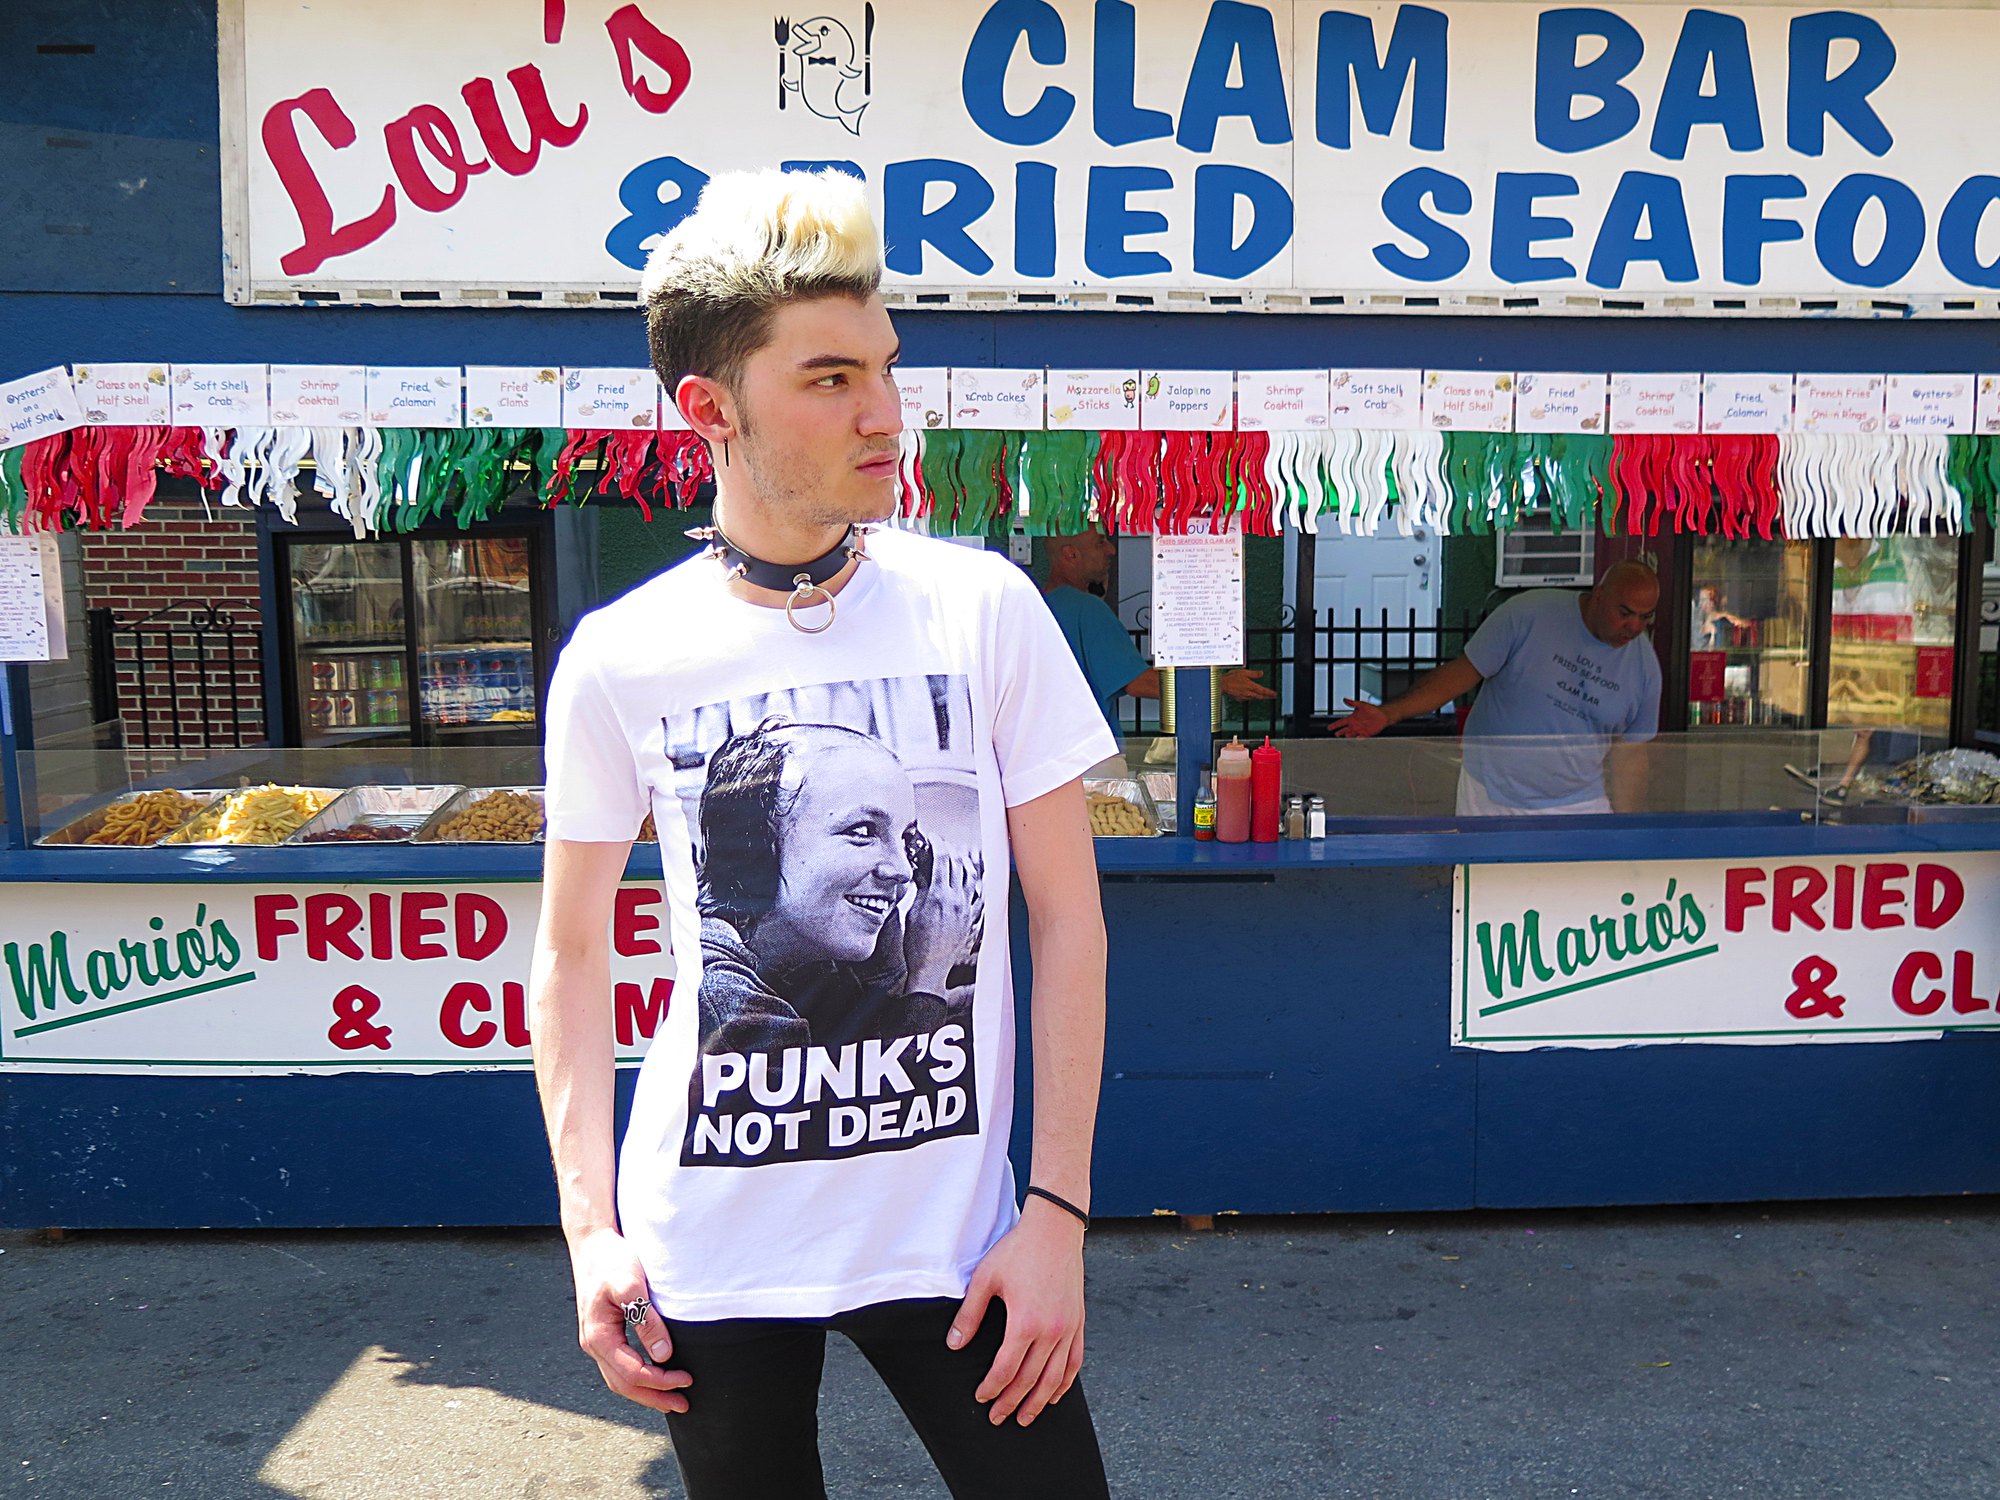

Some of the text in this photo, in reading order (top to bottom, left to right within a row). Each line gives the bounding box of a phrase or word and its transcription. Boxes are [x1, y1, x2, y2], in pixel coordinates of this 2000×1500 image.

[962, 0, 1897, 160] CLAM BAR
[261, 0, 691, 276] Lou's
[781, 159, 1293, 279] RIED
[128, 382, 140, 390] on
[193, 380, 248, 392] Soft Shell
[301, 380, 338, 392] Shrimp
[401, 382, 429, 393] Fried
[500, 381, 528, 392] Fried
[597, 384, 625, 394] Fried
[897, 384, 923, 394] conut
[1066, 384, 1121, 395] Mozzarella
[1266, 385, 1301, 397] Shrimp
[1350, 383, 1402, 396] Soft Shell
[7, 385, 46, 404] Oysters
[970, 391, 1026, 402] Crab Cakes
[1474, 388, 1488, 397] on
[1548, 387, 1575, 398] Fried
[1638, 390, 1675, 403] Shrimp
[1734, 392, 1761, 403] Fried
[1809, 387, 1871, 399] French Fries
[1912, 389, 1953, 401] Oysters
[97, 395, 150, 407] Half Shell
[208, 396, 232, 406] Crab
[393, 397, 437, 407] Calamari
[499, 397, 529, 408] Clams
[592, 399, 629, 412] Shrimp
[1078, 399, 1110, 410] Sticks
[1169, 400, 1208, 413] Poppers
[1363, 398, 1388, 409] Crab
[1443, 401, 1493, 412] Half Shell
[23, 405, 33, 414] on
[1543, 402, 1579, 415] Shrimp
[1727, 407, 1768, 419] Calamari
[10, 409, 62, 432] Half Shell
[1905, 414, 1955, 426] Half Shell
[1576, 654, 1602, 674] LOUS
[1552, 653, 1620, 692] FRIED SEAFOOD
[1582, 692, 1600, 706] BAR
[1724, 863, 1965, 933] FRIED
[254, 892, 508, 962] FRIED
[1476, 878, 1706, 999] Mario's
[3, 902, 241, 1021] Mario's
[1784, 950, 2000, 1019] & CL
[328, 977, 676, 1050] & CLM
[702, 1024, 967, 1108] PUNK'S
[692, 1086, 967, 1156] NOT DEAD
